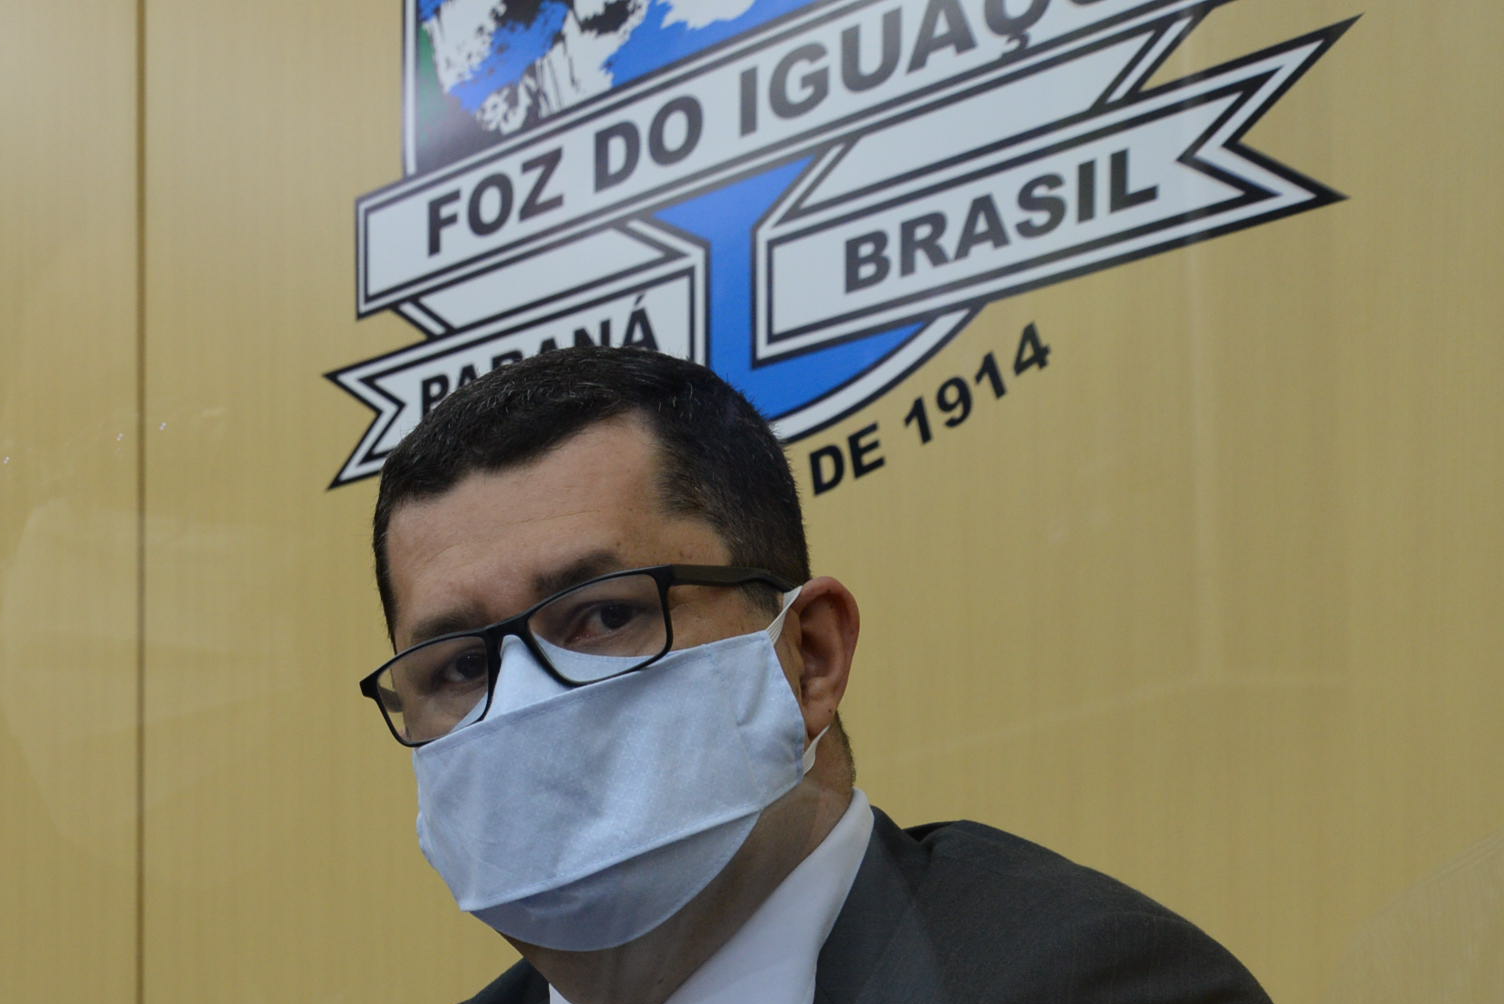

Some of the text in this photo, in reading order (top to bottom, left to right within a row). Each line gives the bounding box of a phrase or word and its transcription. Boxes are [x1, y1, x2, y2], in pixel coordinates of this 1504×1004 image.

[427, 0, 1100, 258] FOZ DO IGUAÇ
[843, 147, 1159, 295] BRASIL
[808, 320, 1052, 497] DE 1914
